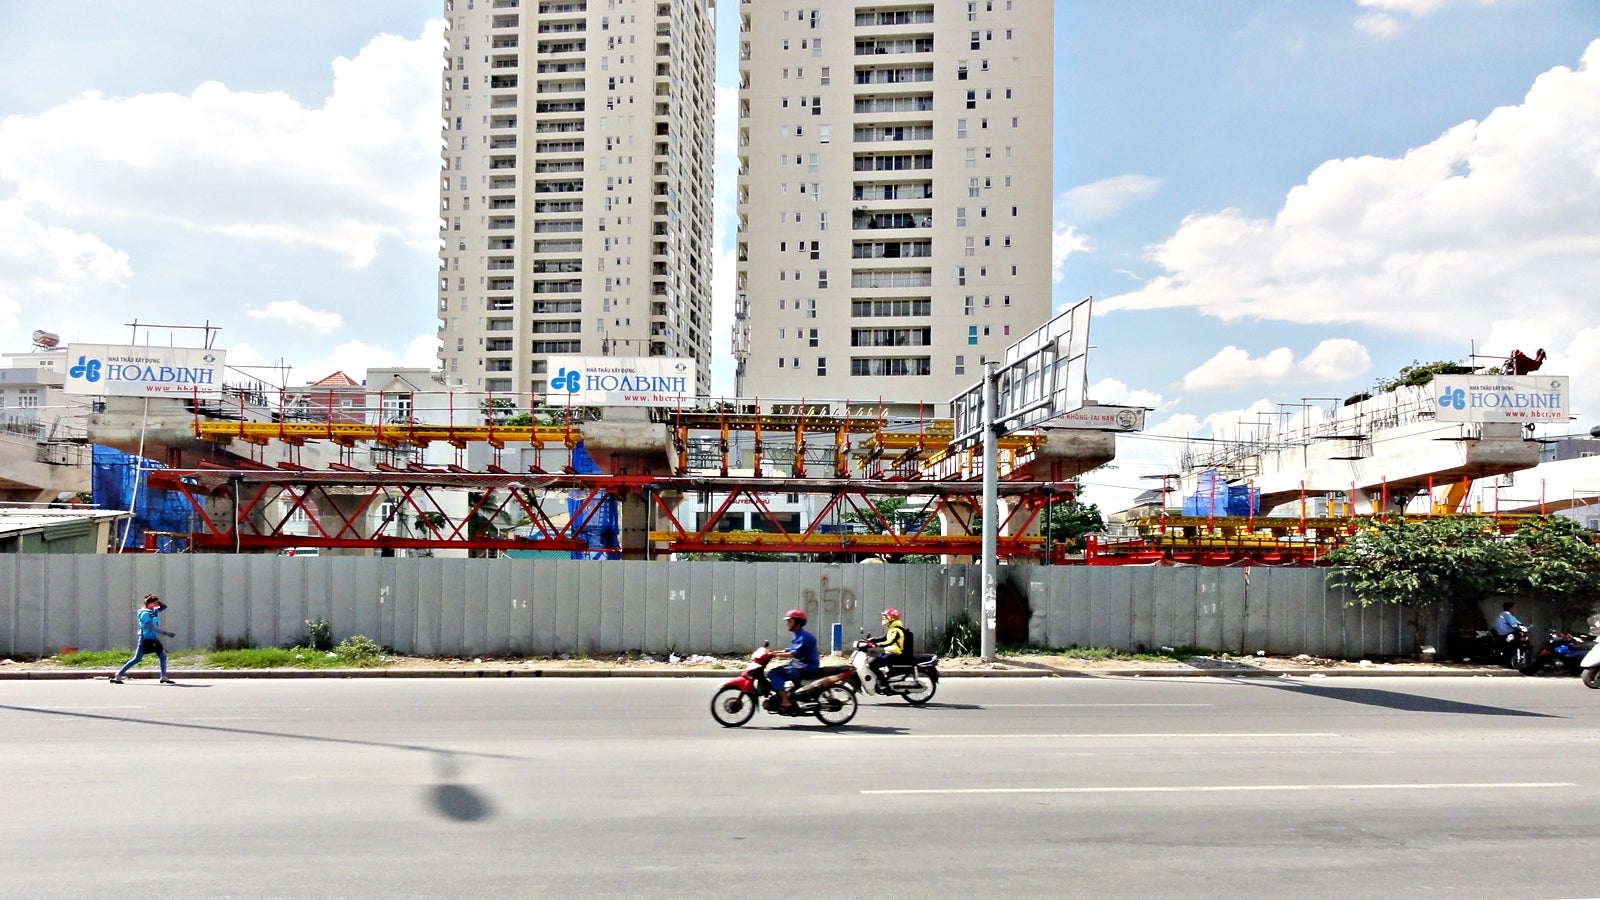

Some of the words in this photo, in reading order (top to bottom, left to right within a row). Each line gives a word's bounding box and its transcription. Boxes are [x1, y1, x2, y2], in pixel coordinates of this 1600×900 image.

[106, 364, 214, 384] HOABINH
[585, 375, 687, 392] HOABINH
[1470, 393, 1561, 408] HOABINH
